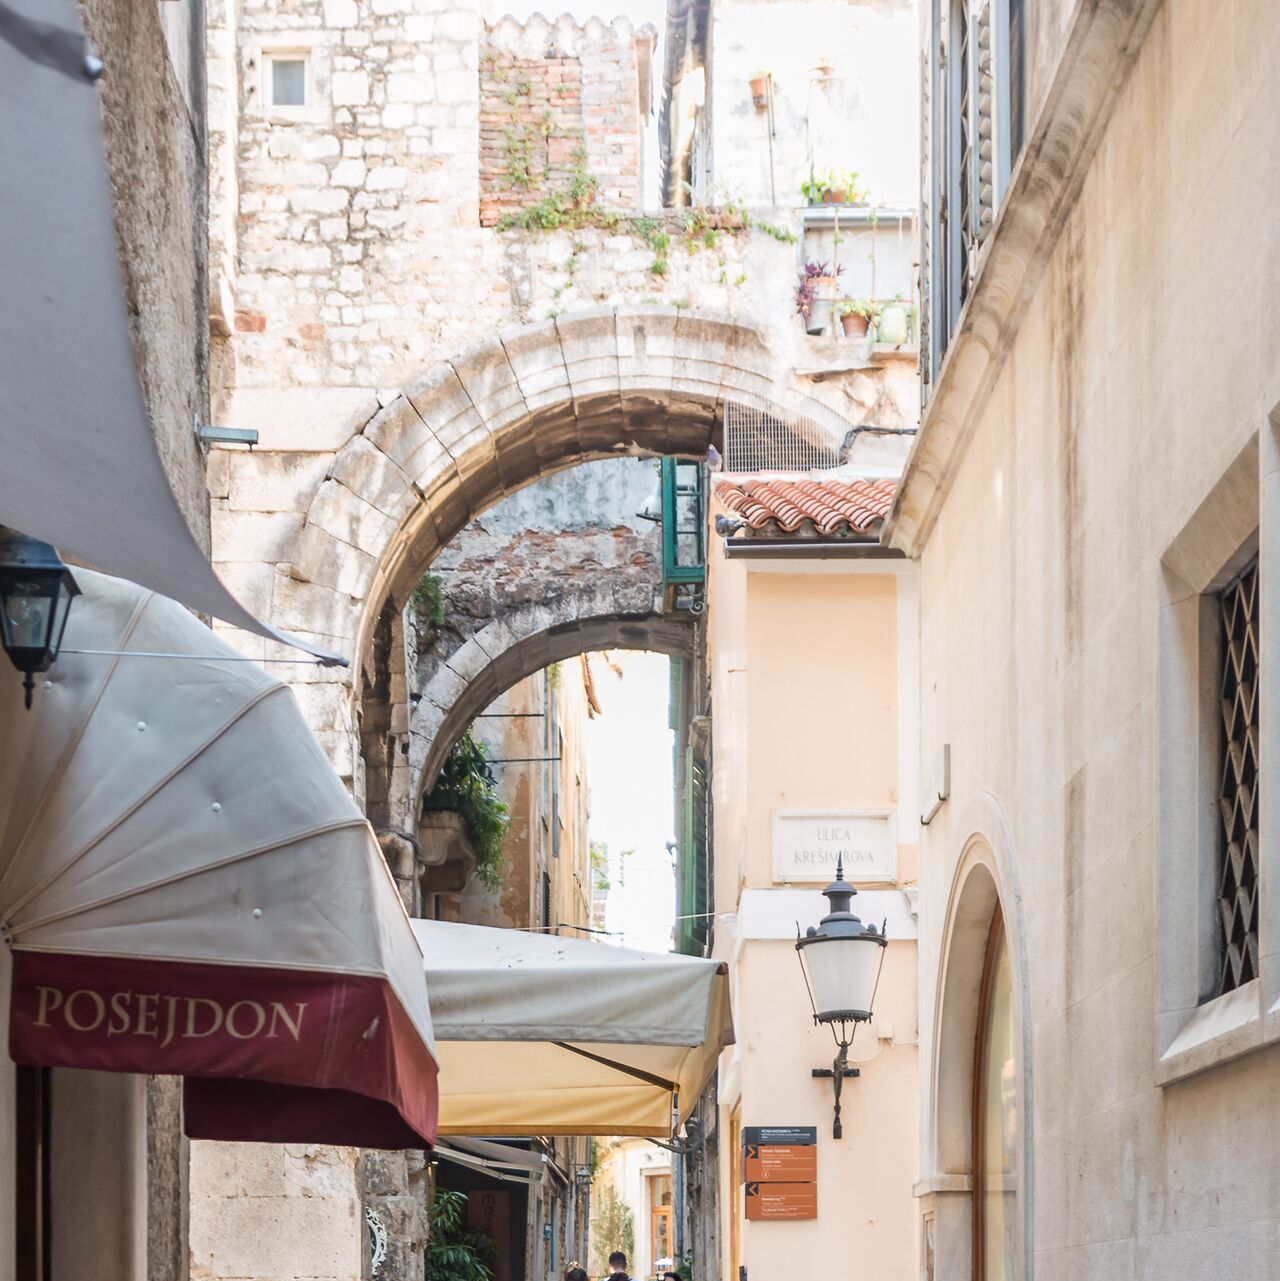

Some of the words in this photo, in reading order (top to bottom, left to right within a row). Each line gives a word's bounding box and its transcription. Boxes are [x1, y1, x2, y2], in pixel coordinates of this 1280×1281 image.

[816, 827, 852, 841] ULICA
[793, 847, 875, 864] KREŠIMROVA
[31, 985, 309, 1048] POSEJDON
